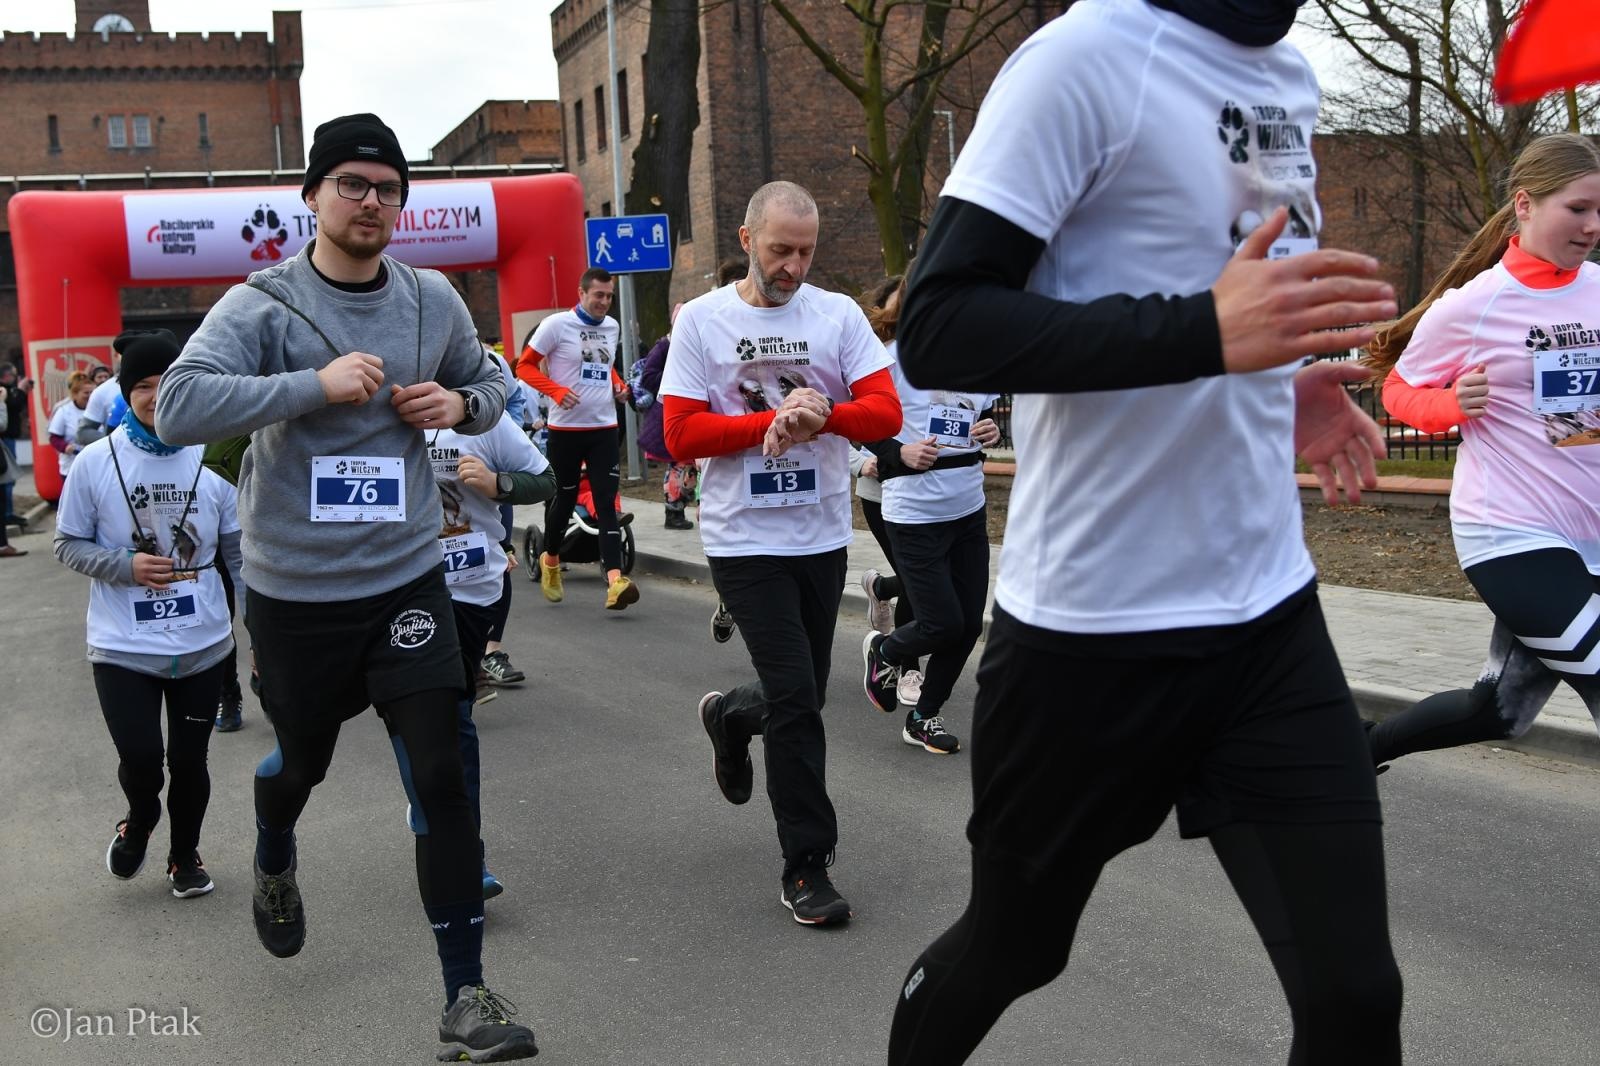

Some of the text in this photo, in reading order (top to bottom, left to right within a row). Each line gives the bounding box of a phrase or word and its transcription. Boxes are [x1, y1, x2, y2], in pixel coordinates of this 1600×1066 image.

[160, 219, 215, 230] Raciborskie
[1552, 322, 1584, 333] TROPEM
[758, 336, 784, 345] TROPEM
[1555, 328, 1600, 348] WILCZY
[760, 341, 809, 354] WILCZYM
[591, 370, 602, 379] 94
[1567, 370, 1598, 394] 37
[943, 420, 960, 436] 38
[431, 448, 459, 460] CZYM
[351, 466, 381, 474] WILCZYM
[772, 472, 798, 492] 13
[344, 480, 378, 504] 76
[444, 551, 470, 571] 12
[153, 599, 180, 619] 92
